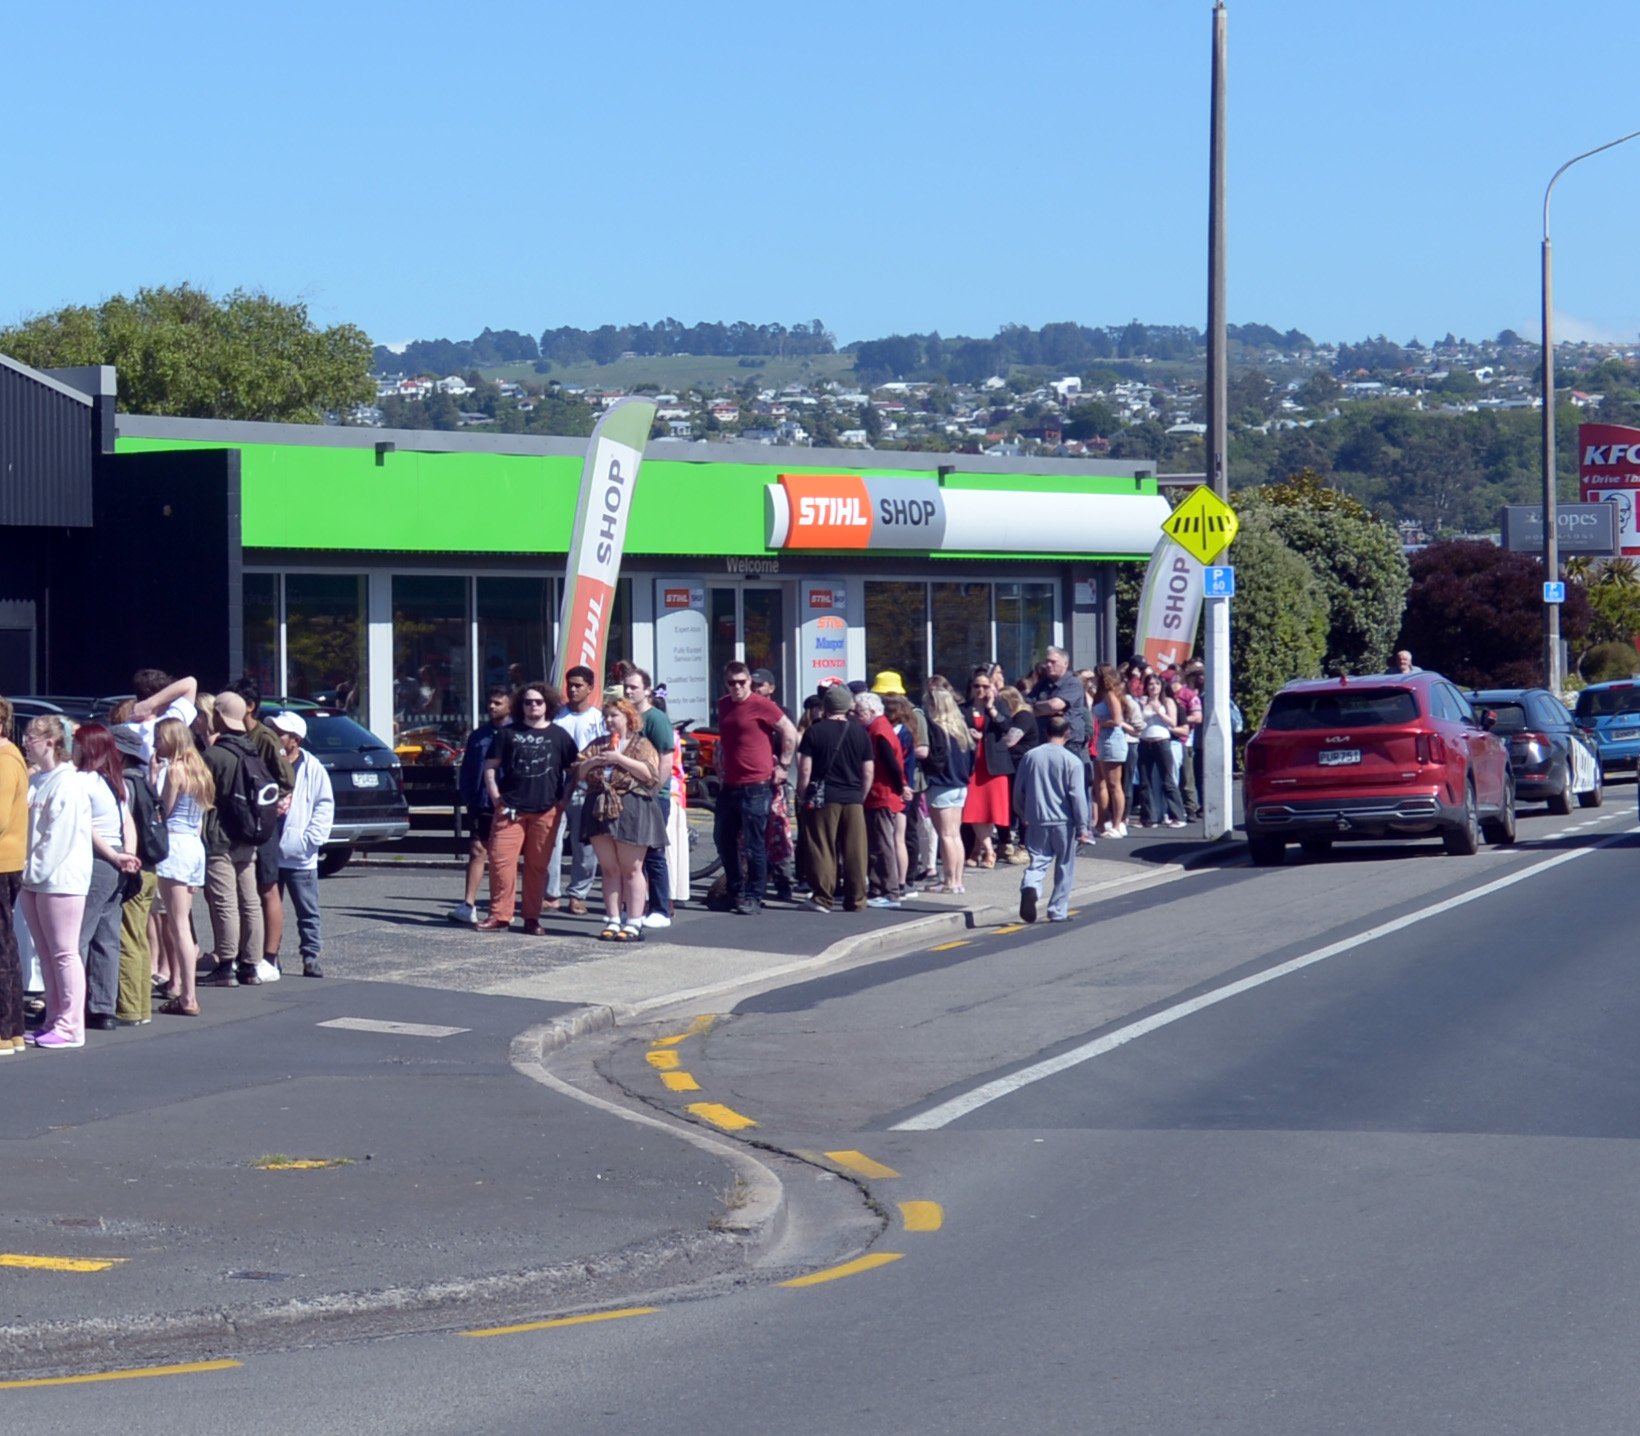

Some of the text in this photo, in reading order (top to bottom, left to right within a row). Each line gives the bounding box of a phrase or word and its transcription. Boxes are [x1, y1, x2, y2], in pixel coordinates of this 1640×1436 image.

[1583, 444, 1640, 466] KFC
[1591, 475, 1620, 484] Drive
[596, 458, 625, 566] SHOP
[798, 496, 937, 527] STIHL SHOP
[1558, 512, 1598, 531] opes
[726, 557, 780, 573] Welcome
[1213, 569, 1224, 580] P
[1163, 556, 1191, 630] SHOP
[579, 592, 604, 668] TIHL
